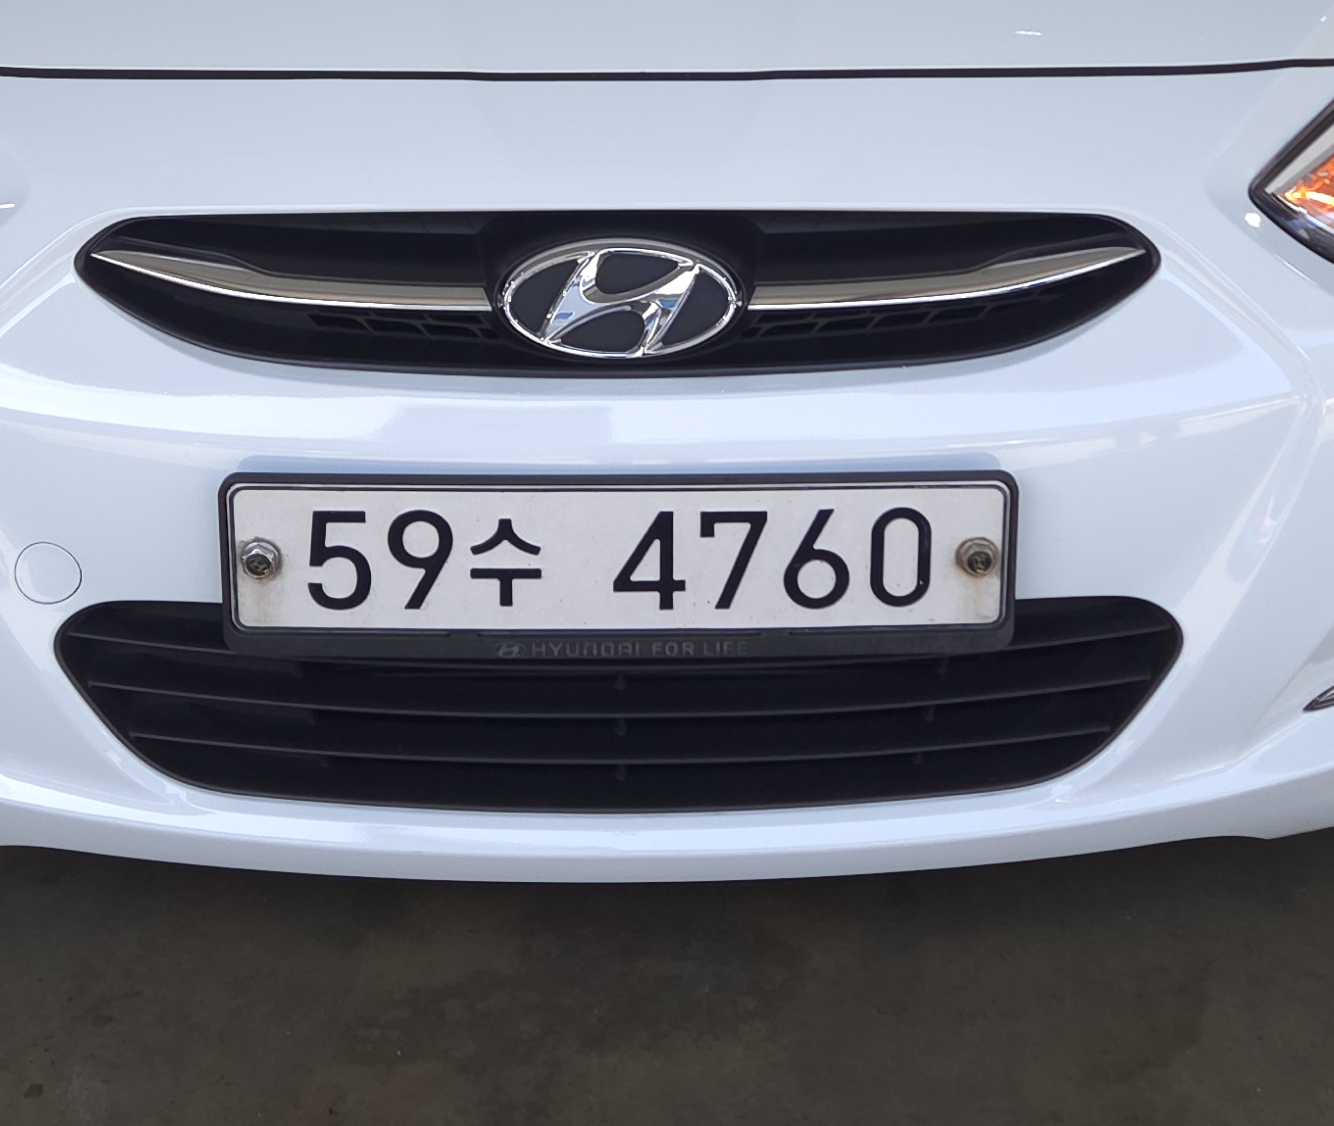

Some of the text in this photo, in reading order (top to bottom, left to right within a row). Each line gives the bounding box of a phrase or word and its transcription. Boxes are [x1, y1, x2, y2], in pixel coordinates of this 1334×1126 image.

[307, 507, 932, 611] 59수 4760
[531, 640, 749, 657] HYUNDAI FOR LIFE
